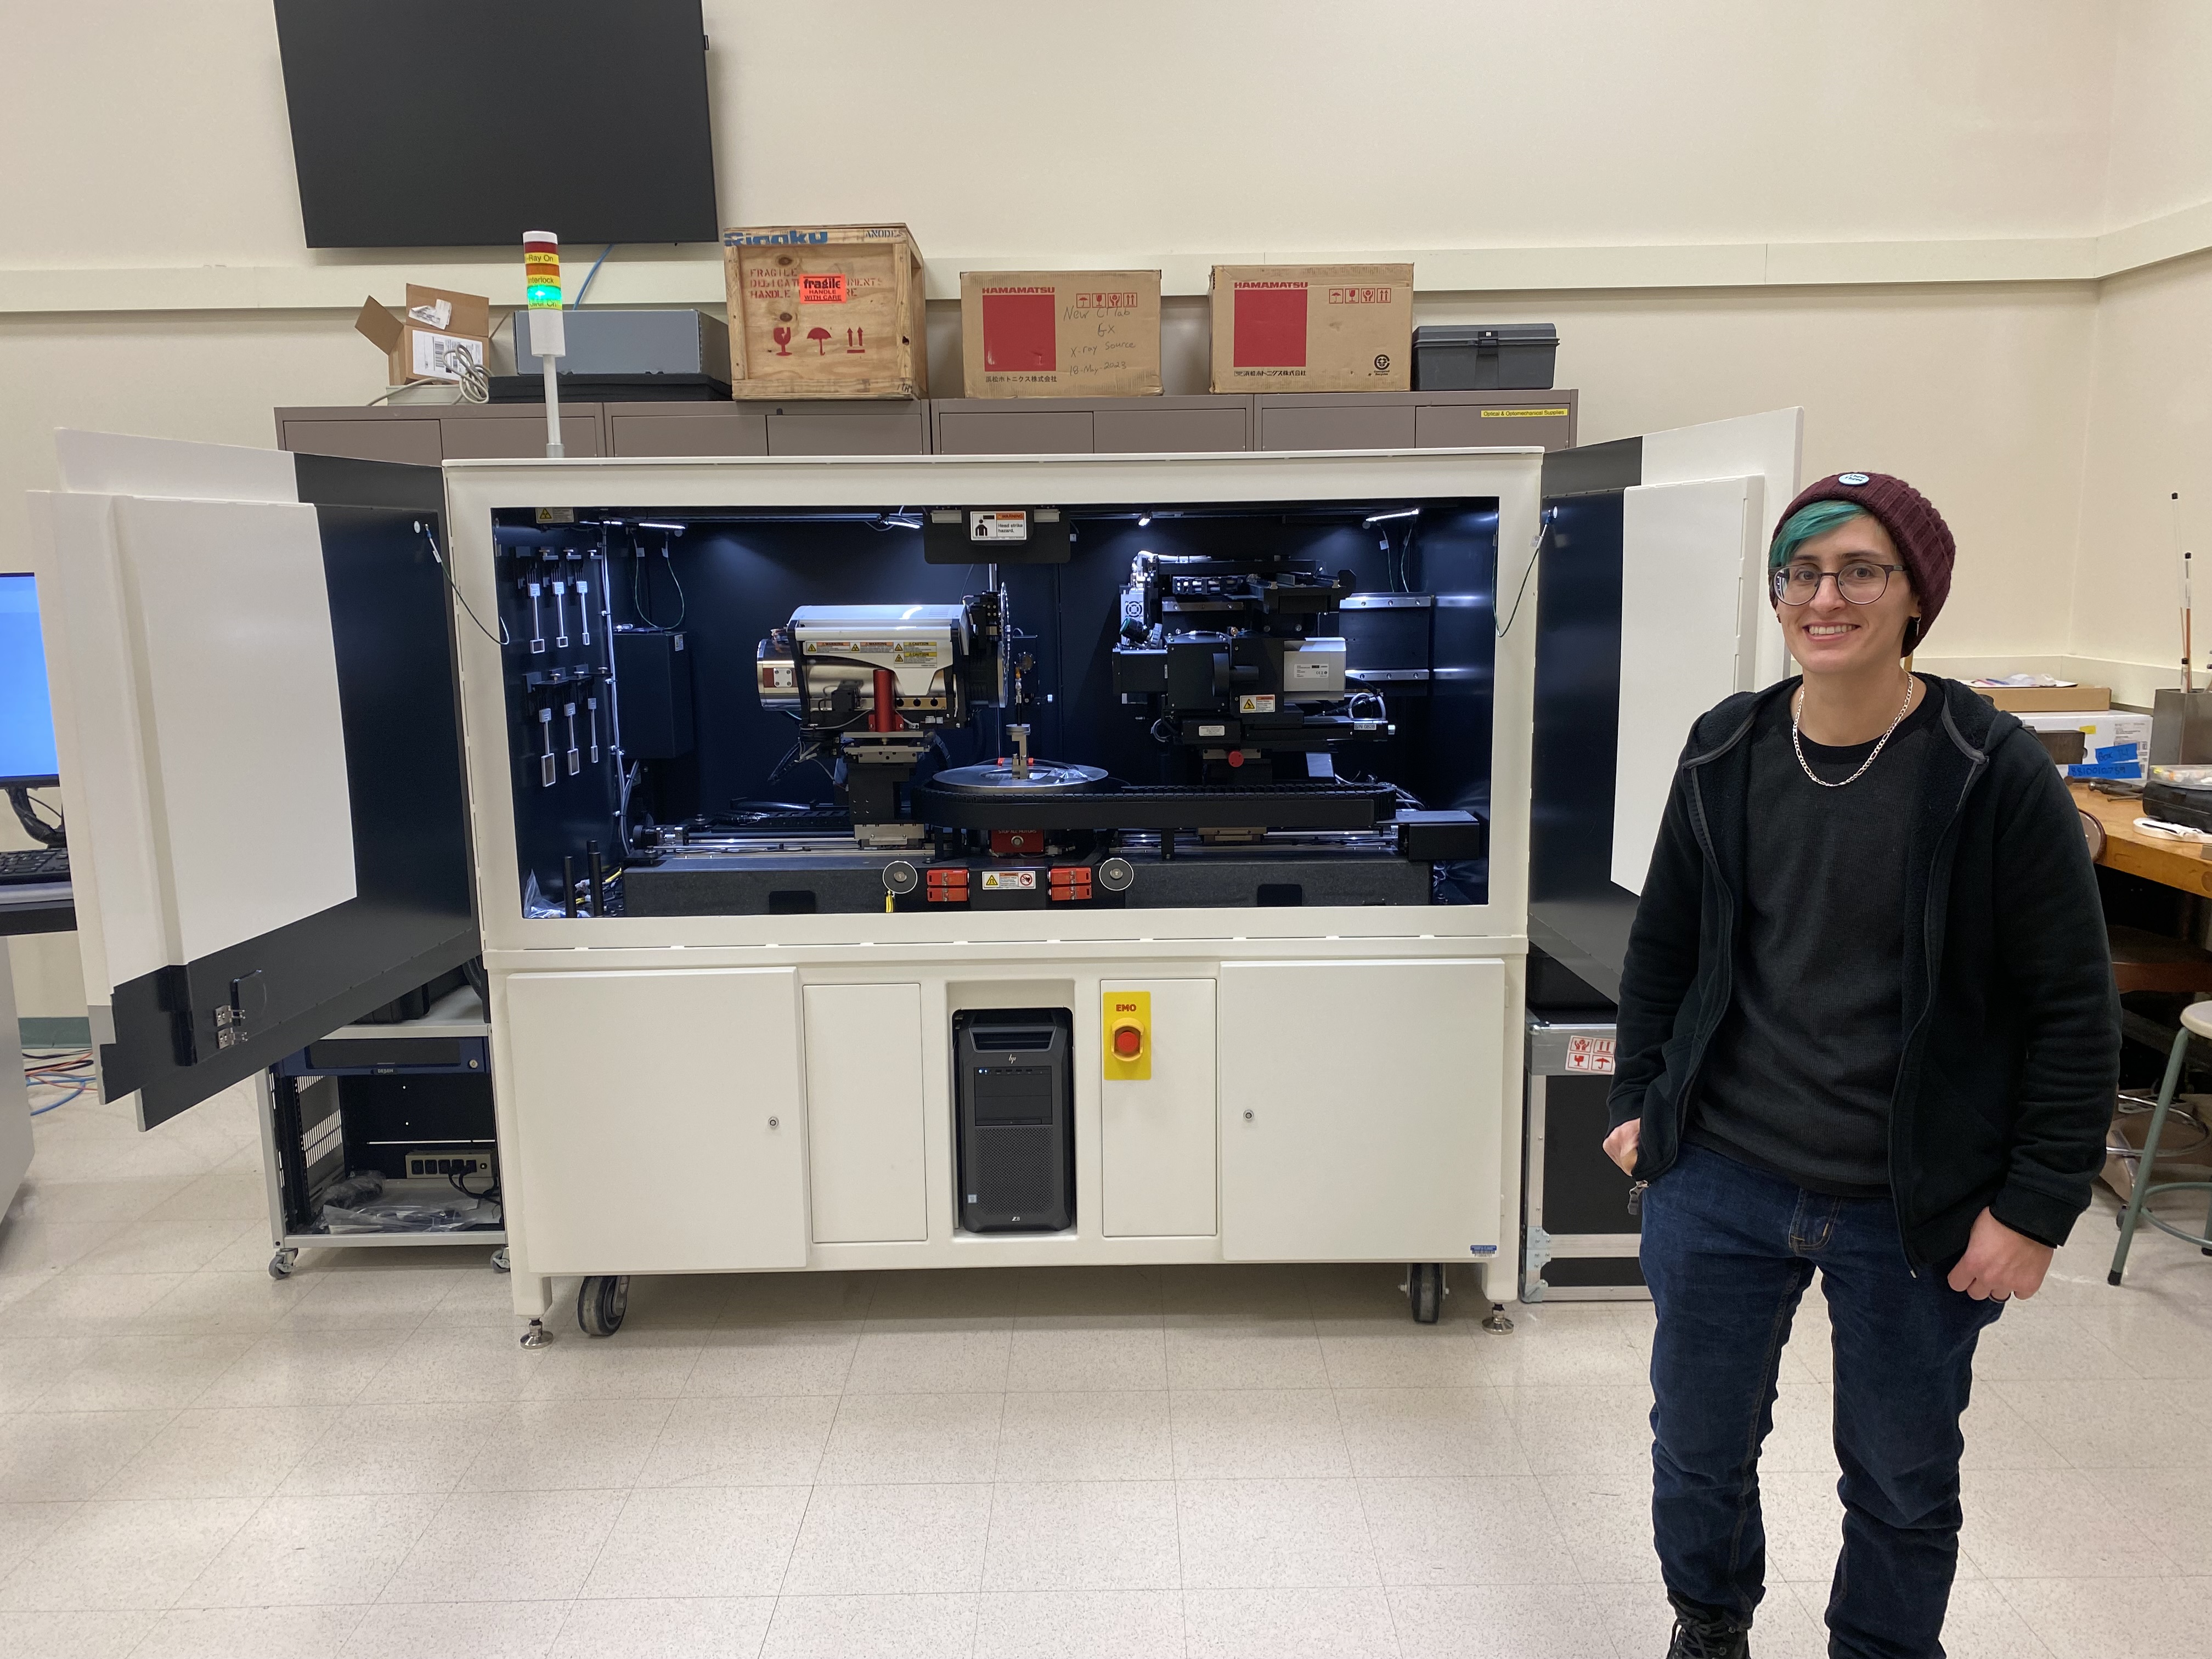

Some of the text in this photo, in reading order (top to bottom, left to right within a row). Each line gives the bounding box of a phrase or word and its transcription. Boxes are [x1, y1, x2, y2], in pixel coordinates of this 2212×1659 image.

[865, 229, 903, 238] ANODES
[750, 268, 797, 277] FRAGILE
[803, 279, 840, 289] fragile
[750, 290, 791, 299] HANDLE
[1063, 305, 1090, 322] New
[1070, 346, 1097, 358] X-ray
[1070, 361, 1127, 376] 18-May-2023
